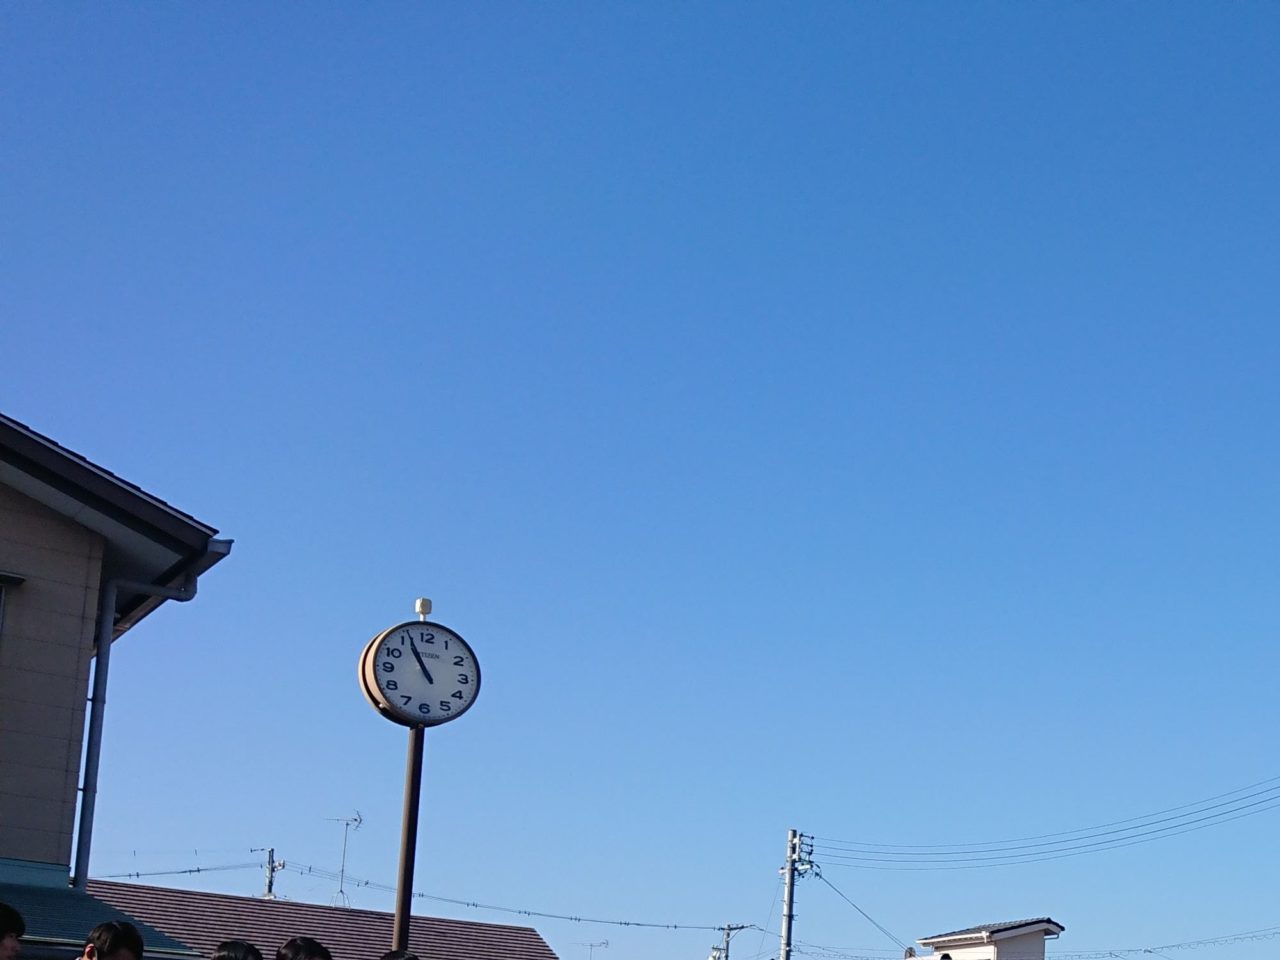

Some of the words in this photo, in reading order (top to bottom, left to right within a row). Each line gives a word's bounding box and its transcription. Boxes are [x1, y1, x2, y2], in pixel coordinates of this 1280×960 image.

[420, 632, 435, 645] 12
[444, 640, 448, 650] 1
[386, 647, 402, 658] 10
[382, 661, 395, 673] 9
[453, 656, 465, 667] 2
[457, 674, 469, 685] 3
[386, 680, 398, 691] 8
[400, 695, 412, 706] 7
[451, 690, 464, 701] 4
[418, 703, 430, 714] 6
[439, 701, 451, 712] 5
